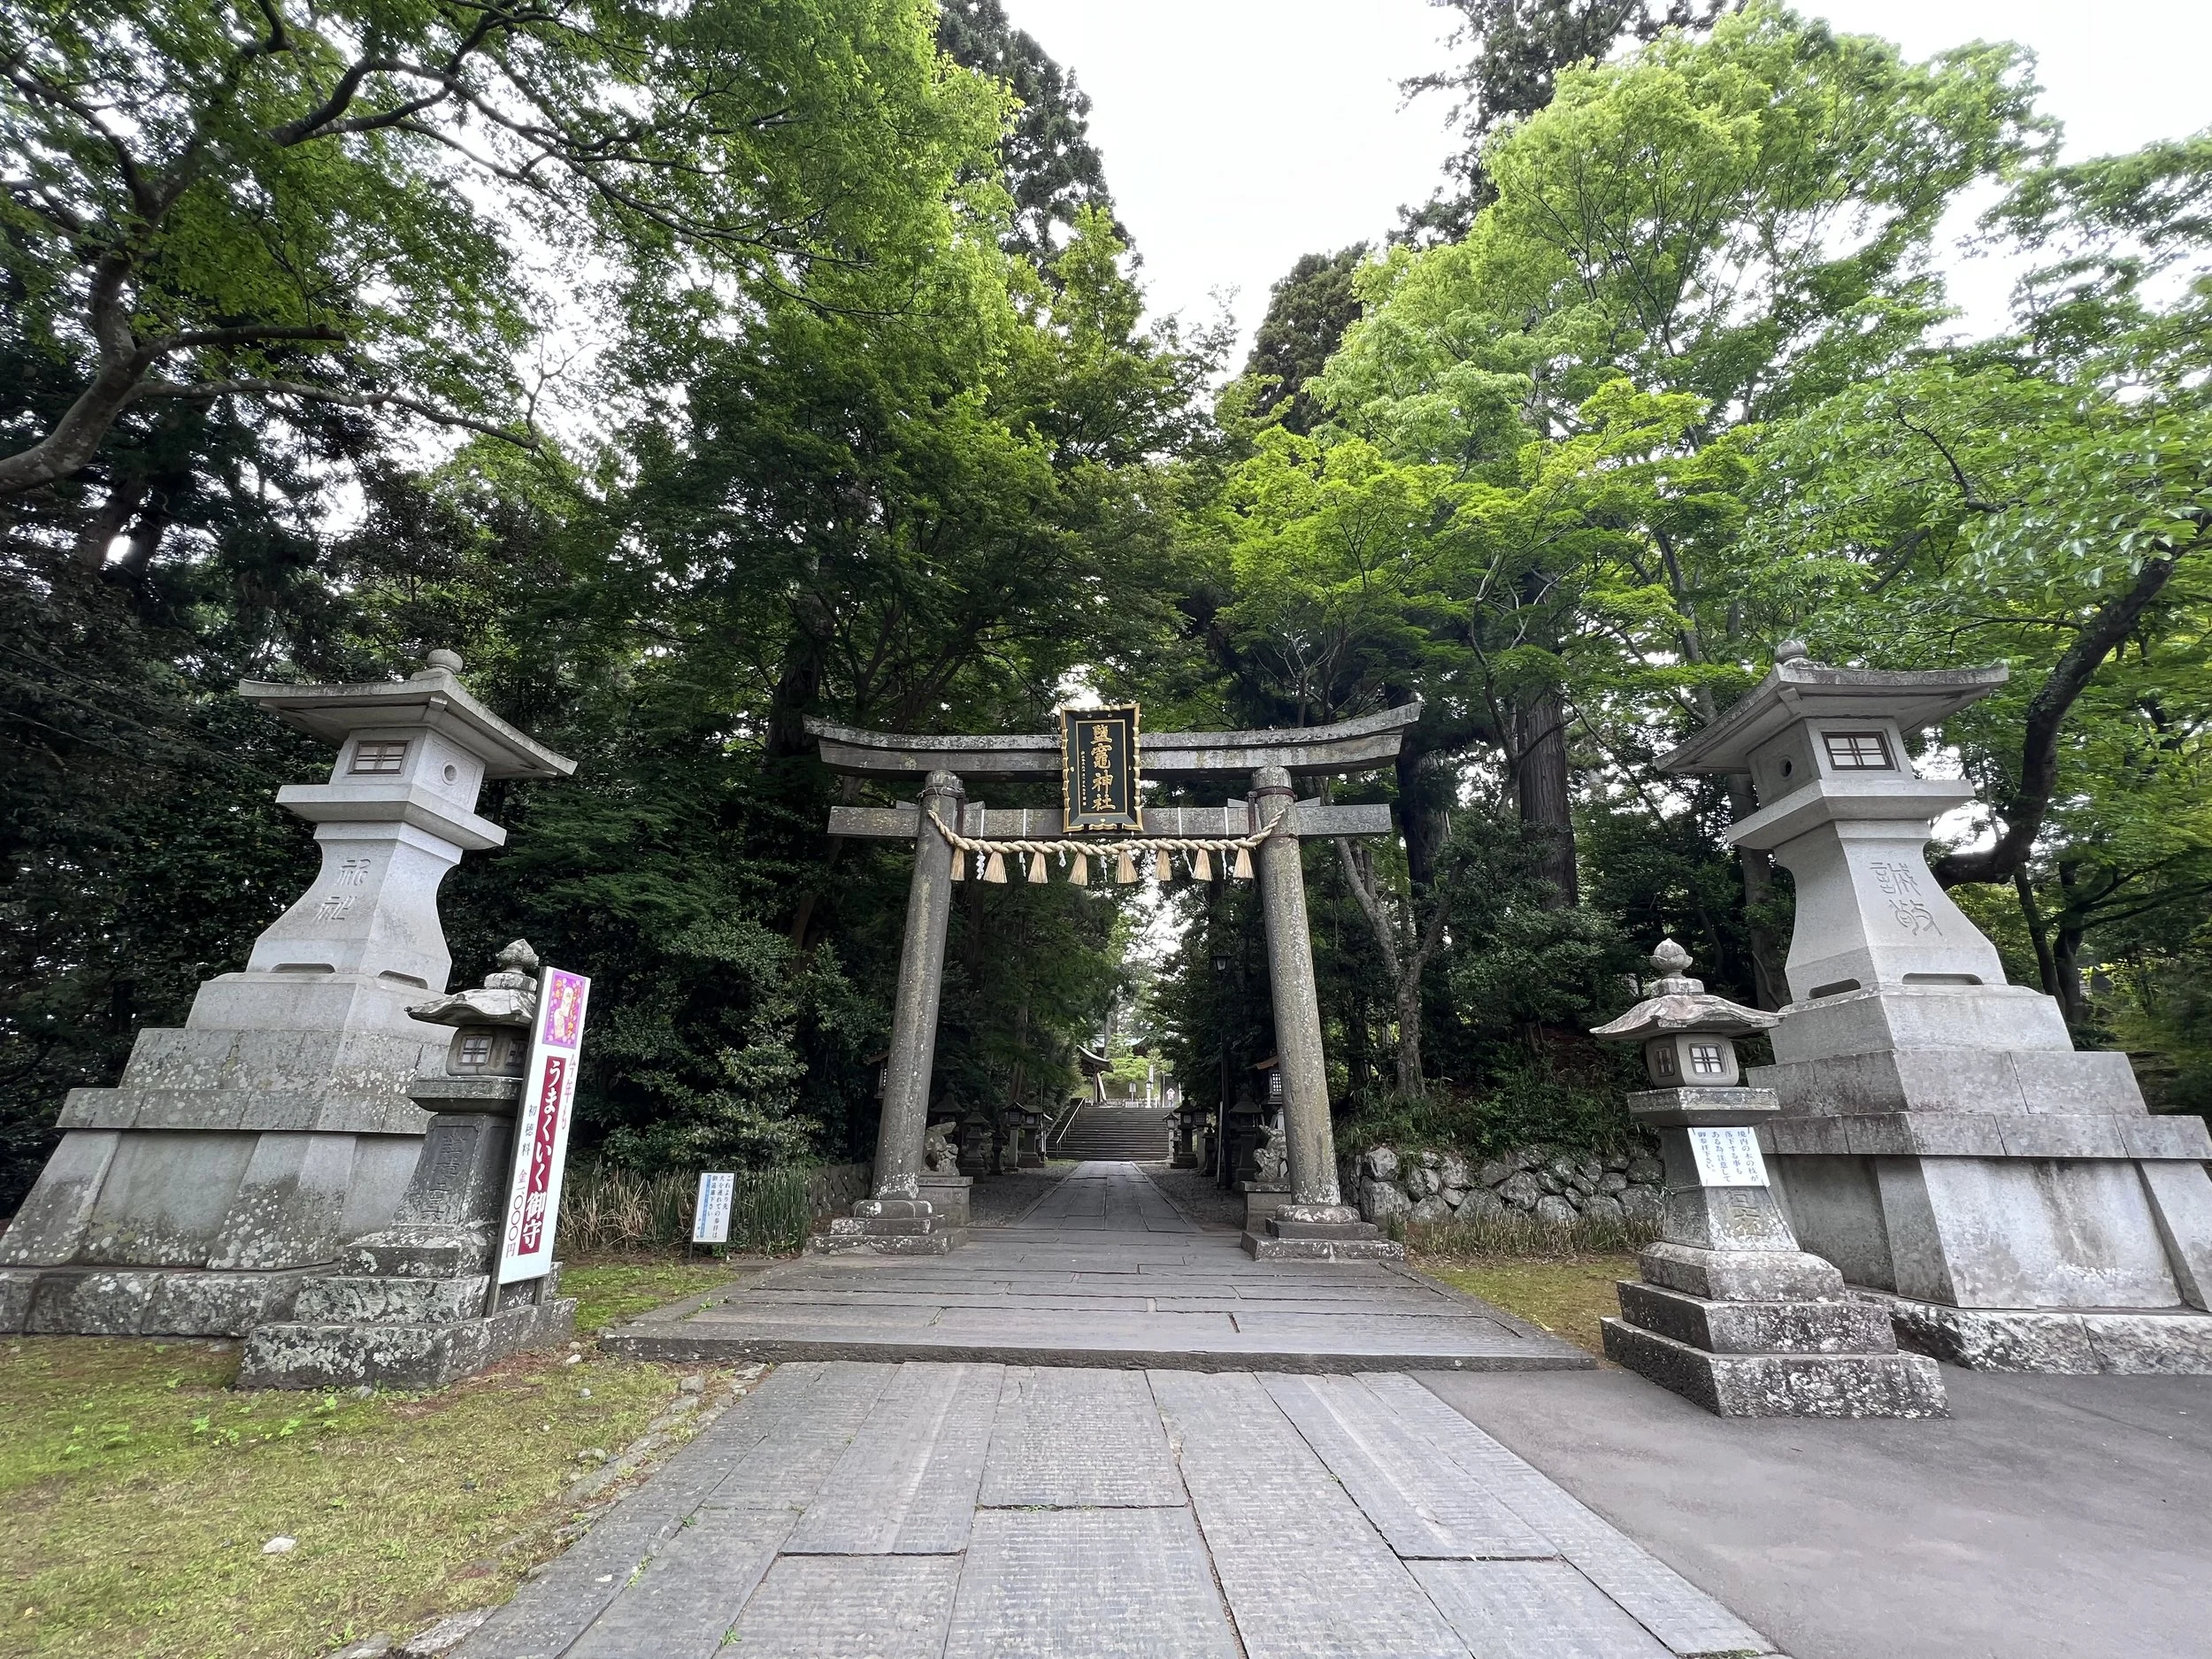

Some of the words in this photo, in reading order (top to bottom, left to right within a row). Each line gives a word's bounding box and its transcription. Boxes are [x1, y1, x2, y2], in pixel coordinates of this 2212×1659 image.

[561, 1054, 577, 1131] 今年も
[520, 1104, 537, 1156] 初穂料
[522, 1059, 561, 1250] うまくいく御守
[1737, 1131, 1759, 1182] 境内の木の枝が
[722, 1175, 732, 1210] これより先
